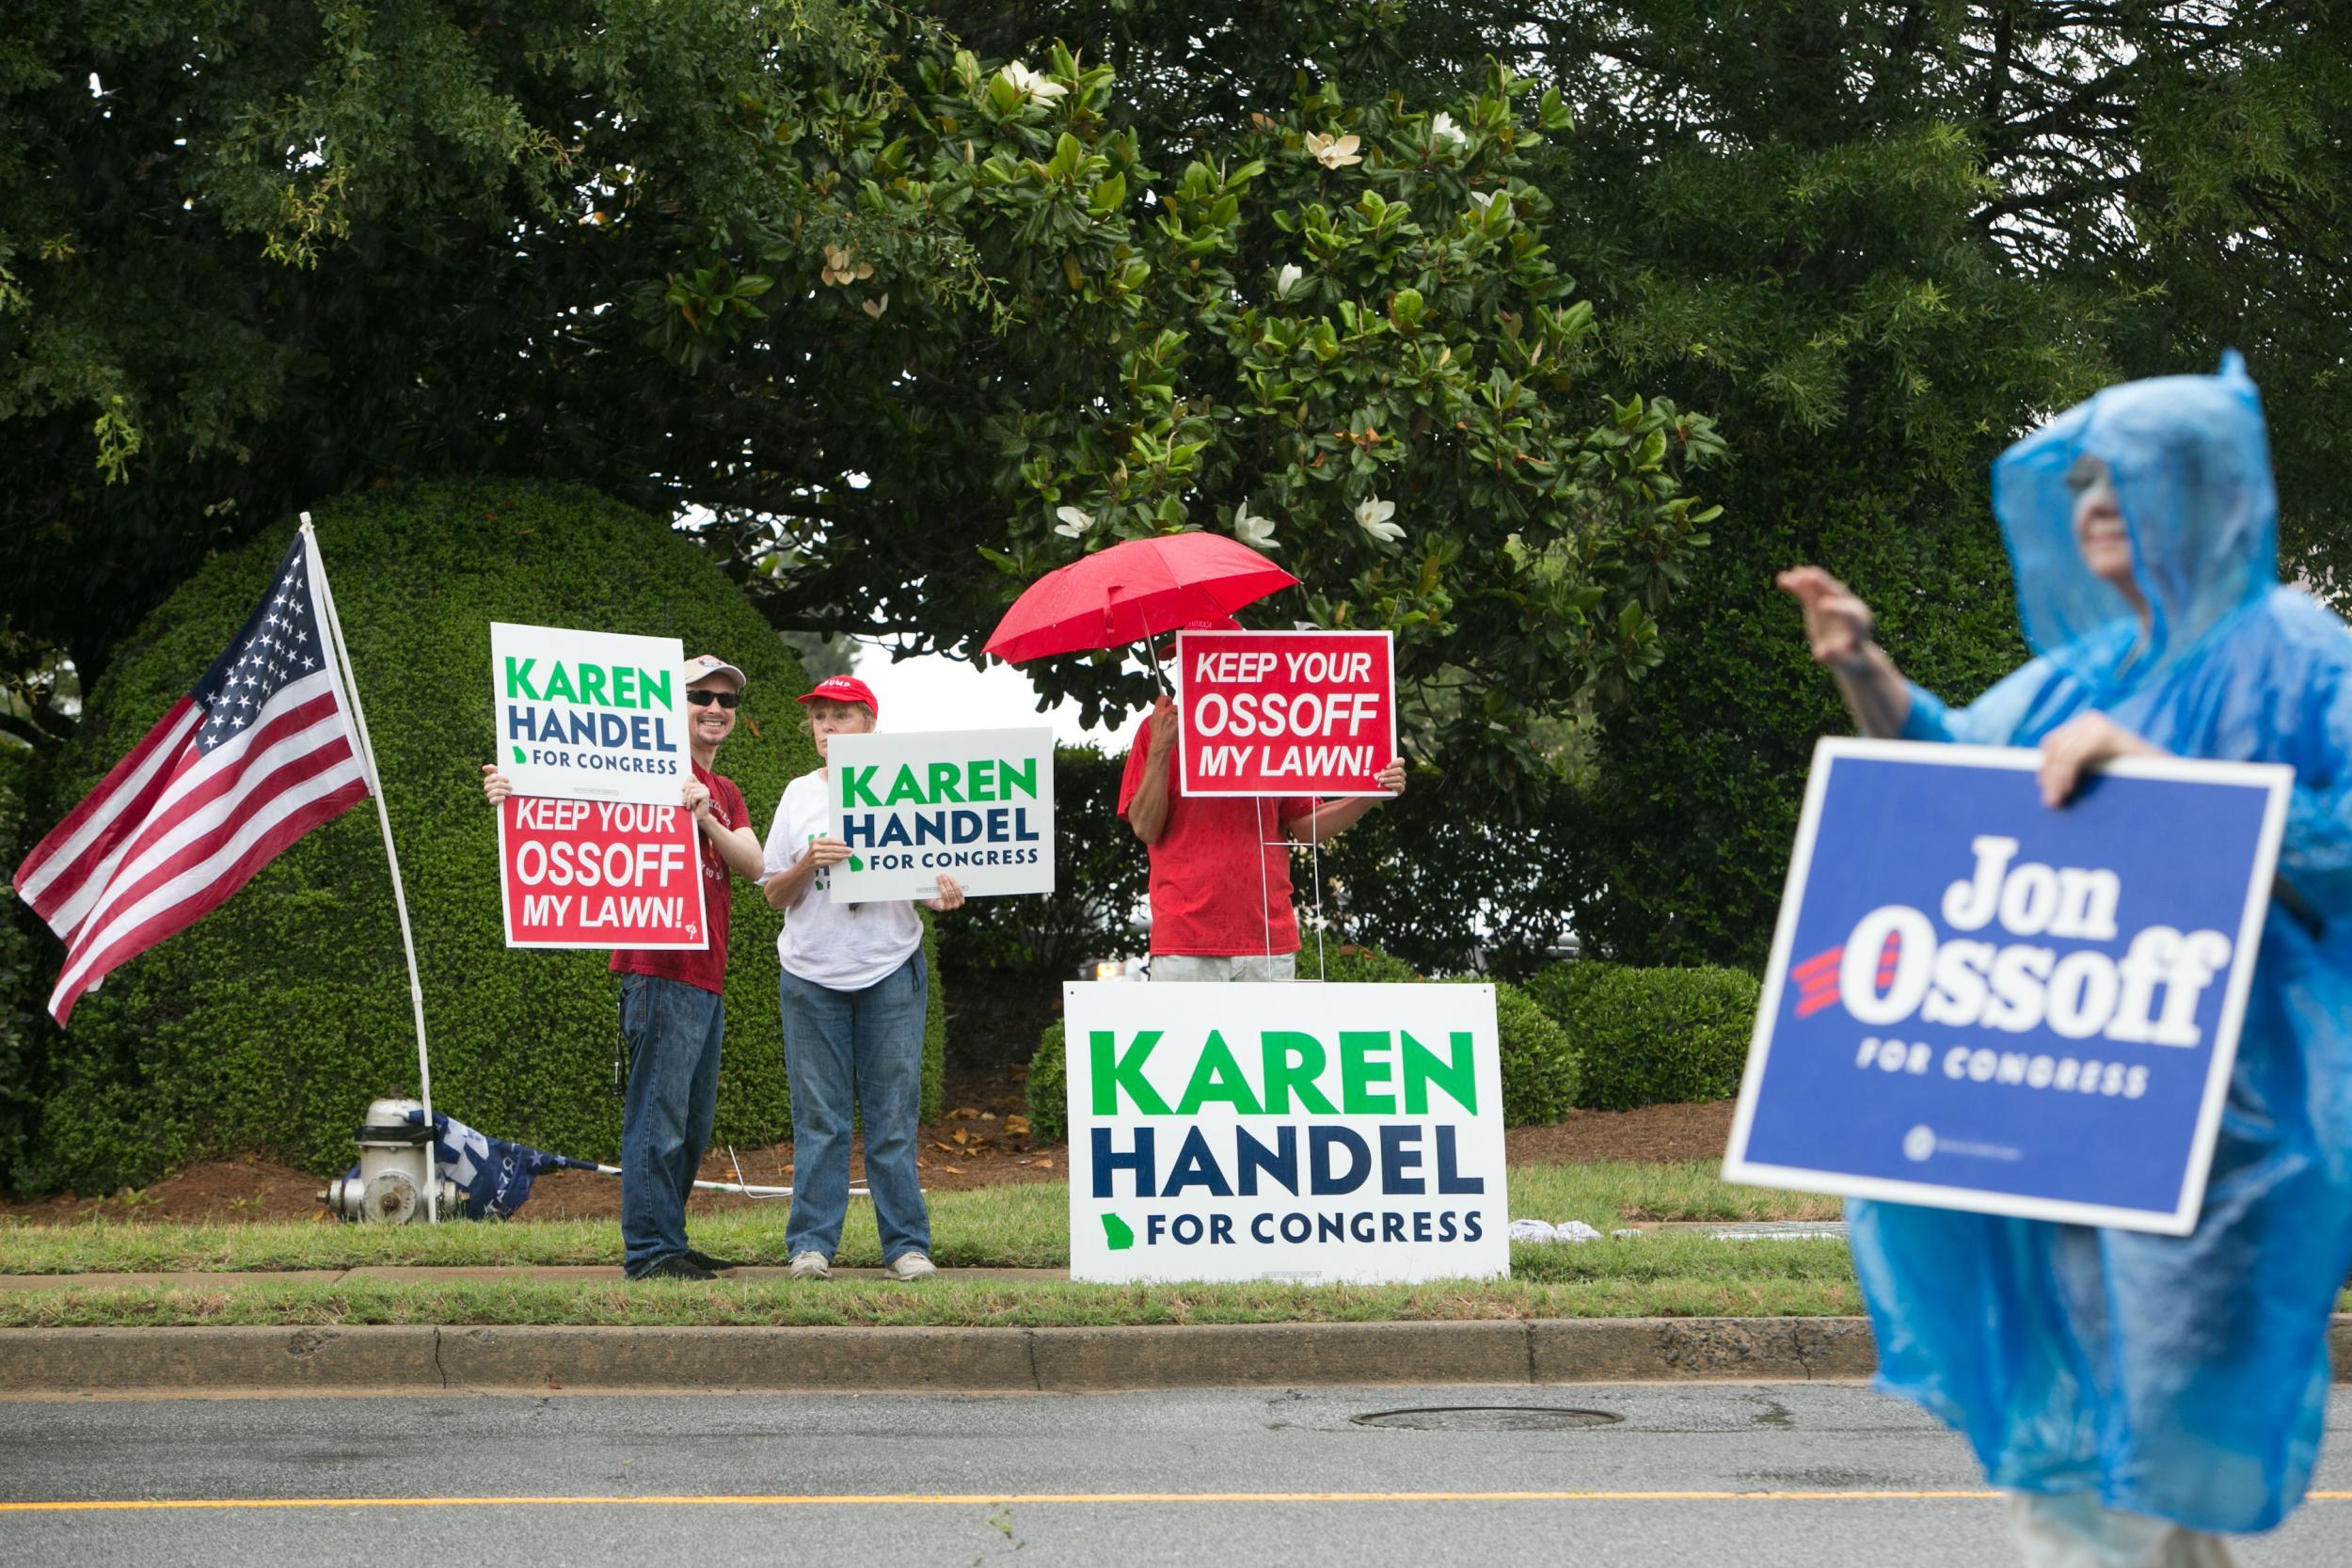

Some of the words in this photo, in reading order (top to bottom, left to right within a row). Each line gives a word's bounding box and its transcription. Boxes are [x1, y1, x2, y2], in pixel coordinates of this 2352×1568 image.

[505, 656, 673, 712] KAREN
[1195, 653, 1277, 683] KEEP
[1285, 653, 1372, 683] YOUR
[508, 705, 677, 752] HANDEL
[1195, 693, 1379, 737] OSSOFF
[532, 750, 570, 768] FOR
[578, 754, 677, 775] CONGRESS
[842, 758, 1038, 808] KAREN
[1199, 746, 1254, 777] MY
[1260, 746, 1375, 777] LAWN!
[516, 799, 590, 831] KEEP
[596, 801, 675, 833] YOUR
[843, 807, 1040, 848] HANDEL
[517, 840, 686, 888] OSSOFF
[870, 853, 914, 871] FOR
[922, 848, 1039, 868] CONGRESS
[1942, 835, 2121, 941] Jon
[522, 895, 572, 927] MY
[580, 896, 683, 928] LAWN!
[1839, 904, 2233, 1049] Ossoff
[1089, 1029, 1478, 1116] KAREN
[1856, 1037, 1931, 1074] FOR
[1944, 1046, 2149, 1099] CONGRESS
[1091, 1125, 1485, 1198] HANDEL
[1147, 1214, 1235, 1245] FOR
[1251, 1211, 1483, 1243] CONGRESS
